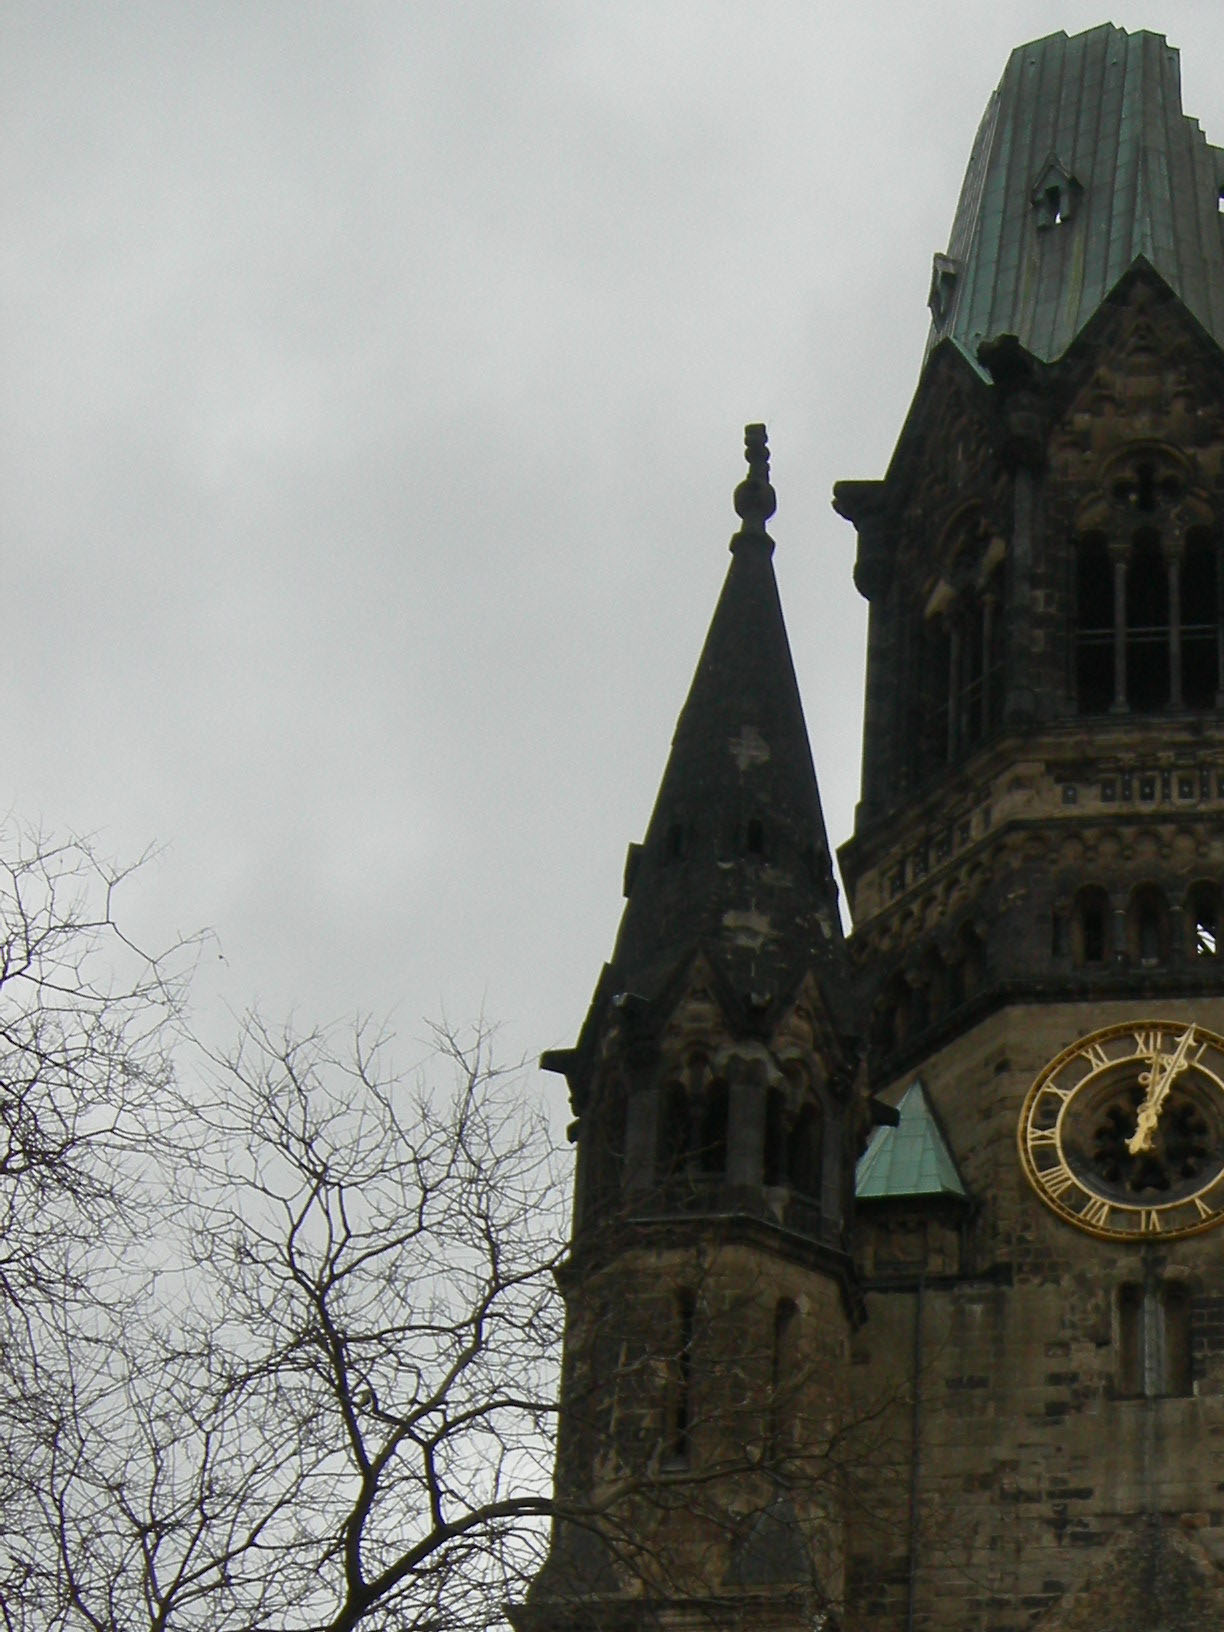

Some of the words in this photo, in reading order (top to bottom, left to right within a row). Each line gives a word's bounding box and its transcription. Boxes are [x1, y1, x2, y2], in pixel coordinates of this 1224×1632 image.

[1134, 1031, 1163, 1056] XII
[1081, 1043, 1110, 1070] XI
[1042, 1080, 1073, 1102] X
[1029, 1126, 1058, 1146] IX
[1038, 1164, 1074, 1198] VIII
[1079, 1197, 1110, 1227] VII
[1141, 1208, 1161, 1233] VI
[1193, 1197, 1213, 1220] V
